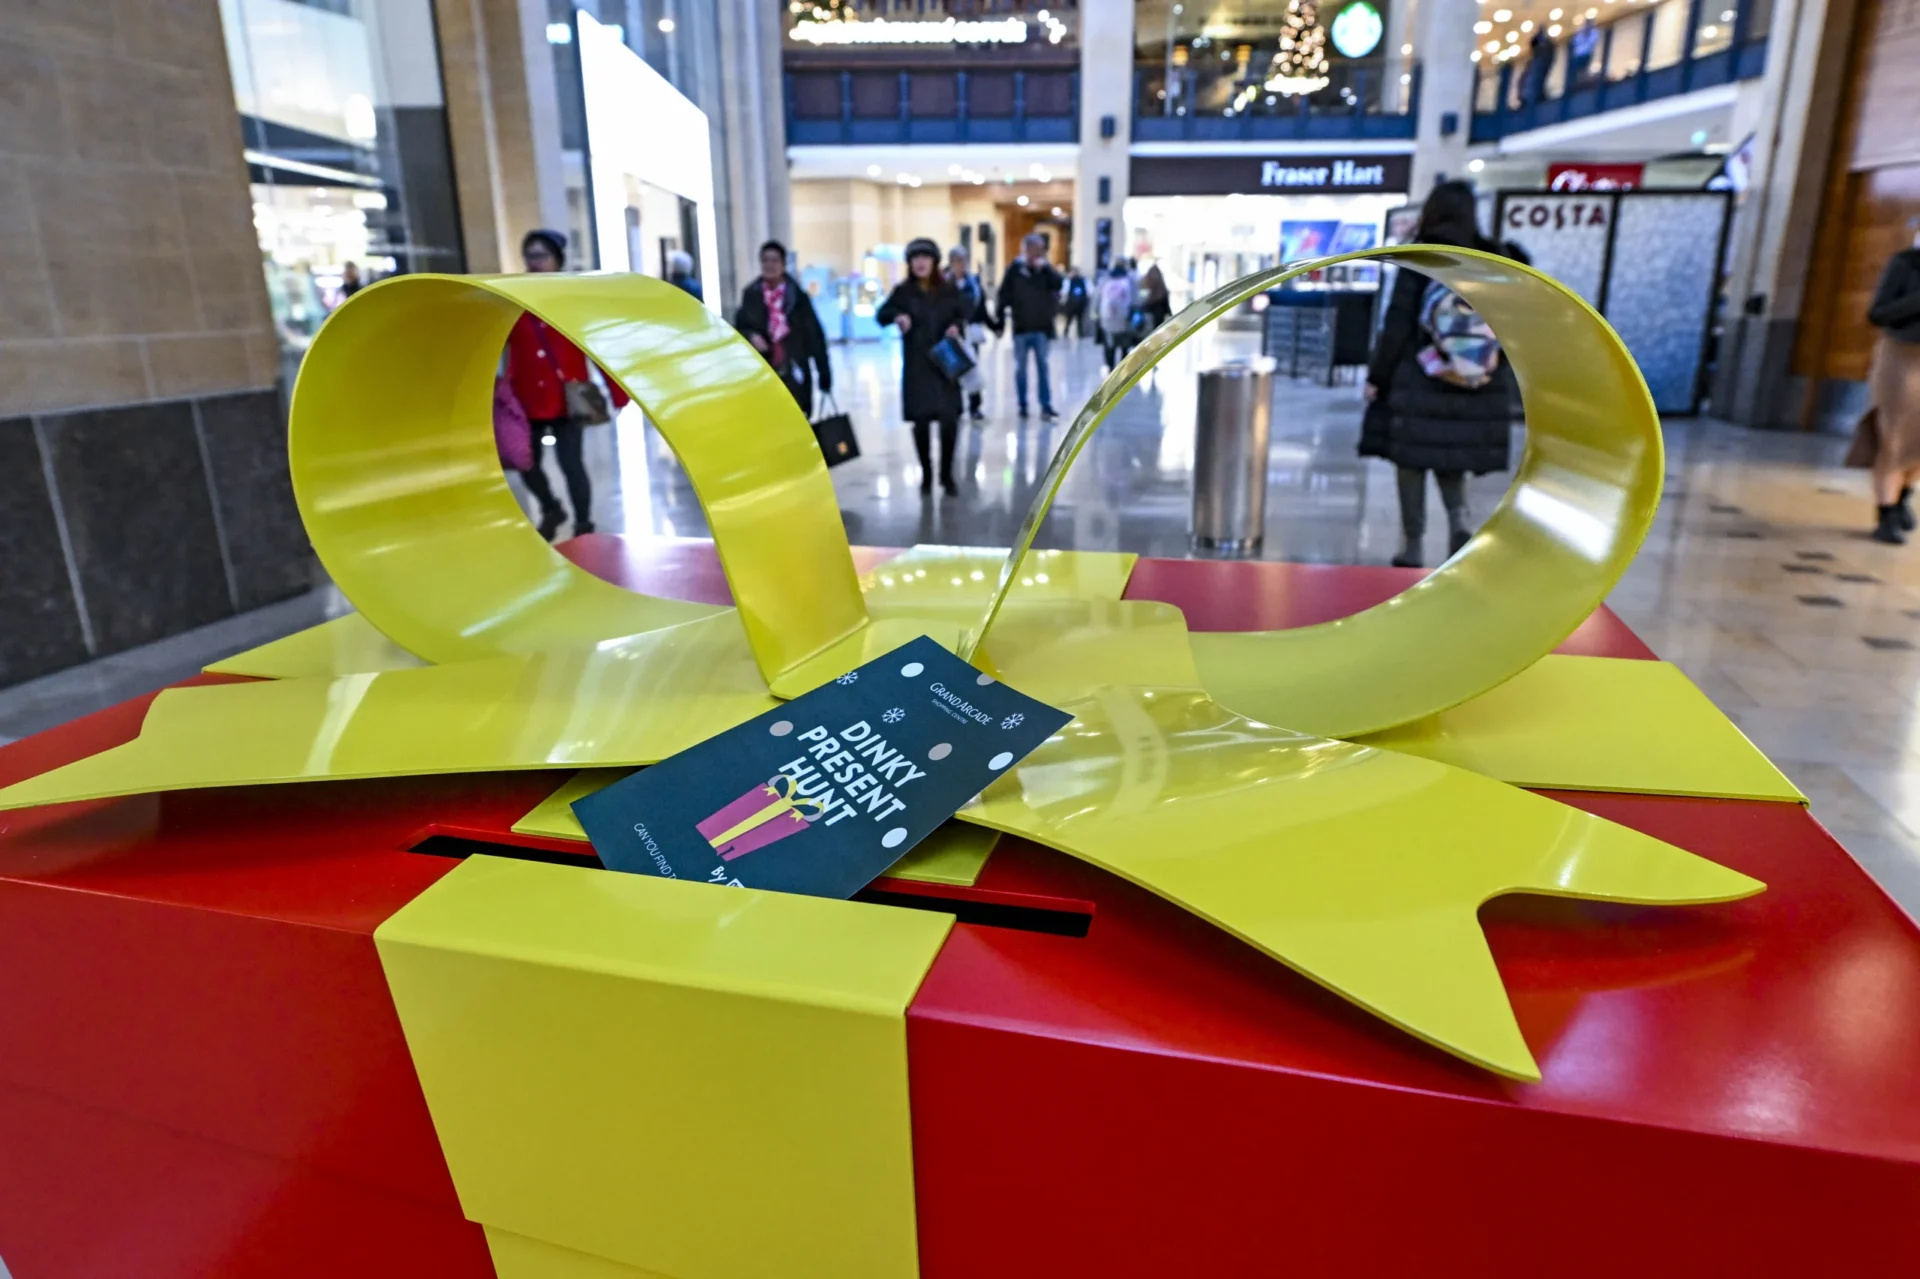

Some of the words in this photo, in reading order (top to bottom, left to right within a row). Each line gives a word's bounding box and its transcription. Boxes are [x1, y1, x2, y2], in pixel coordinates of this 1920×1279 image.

[1261, 161, 1329, 186] Fraser
[1332, 160, 1384, 185] Hart
[1508, 204, 1605, 230] COSTA
[930, 682, 962, 706] GRAND
[956, 701, 993, 725] ARCADE
[931, 698, 953, 714] SHOPPING
[951, 711, 968, 724] CENTRE
[797, 725, 907, 822] PRESENT
[839, 720, 927, 788] DINKY
[778, 756, 858, 826] HUNT
[633, 822, 651, 841] CAN
[643, 837, 661, 857] YOU
[653, 854, 672, 875] FIND
[708, 865, 728, 882] By
